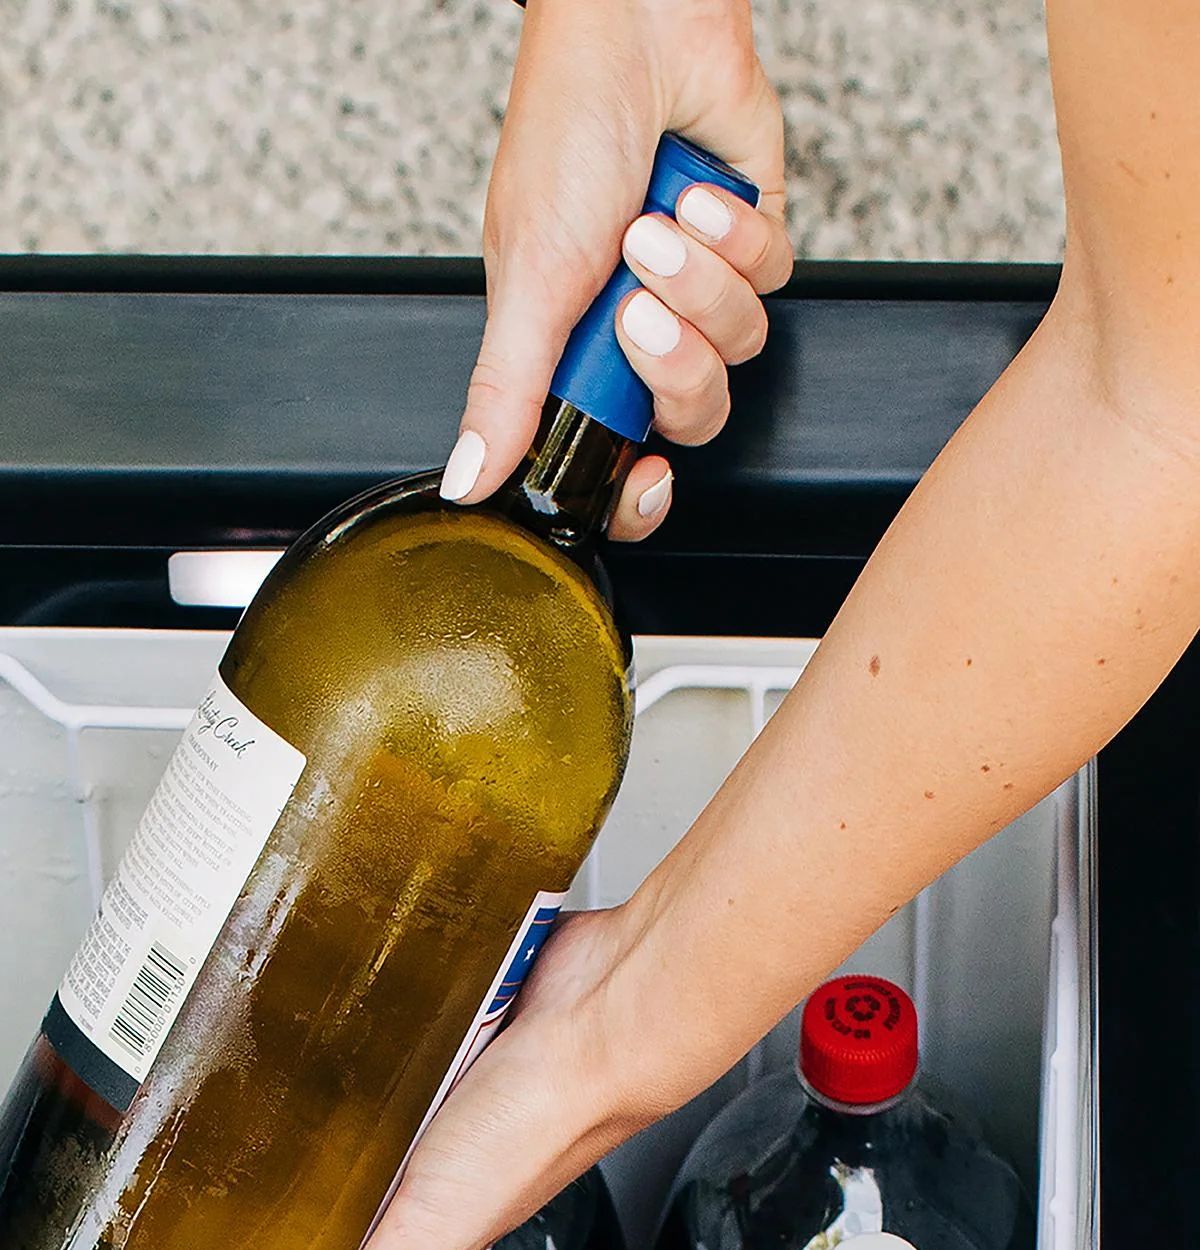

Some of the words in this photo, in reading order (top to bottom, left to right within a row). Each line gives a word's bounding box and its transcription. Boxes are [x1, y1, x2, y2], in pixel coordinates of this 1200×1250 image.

[215, 717, 256, 760] Creek
[146, 1016, 166, 1053] 85000
[164, 977, 186, 1013] 01130
